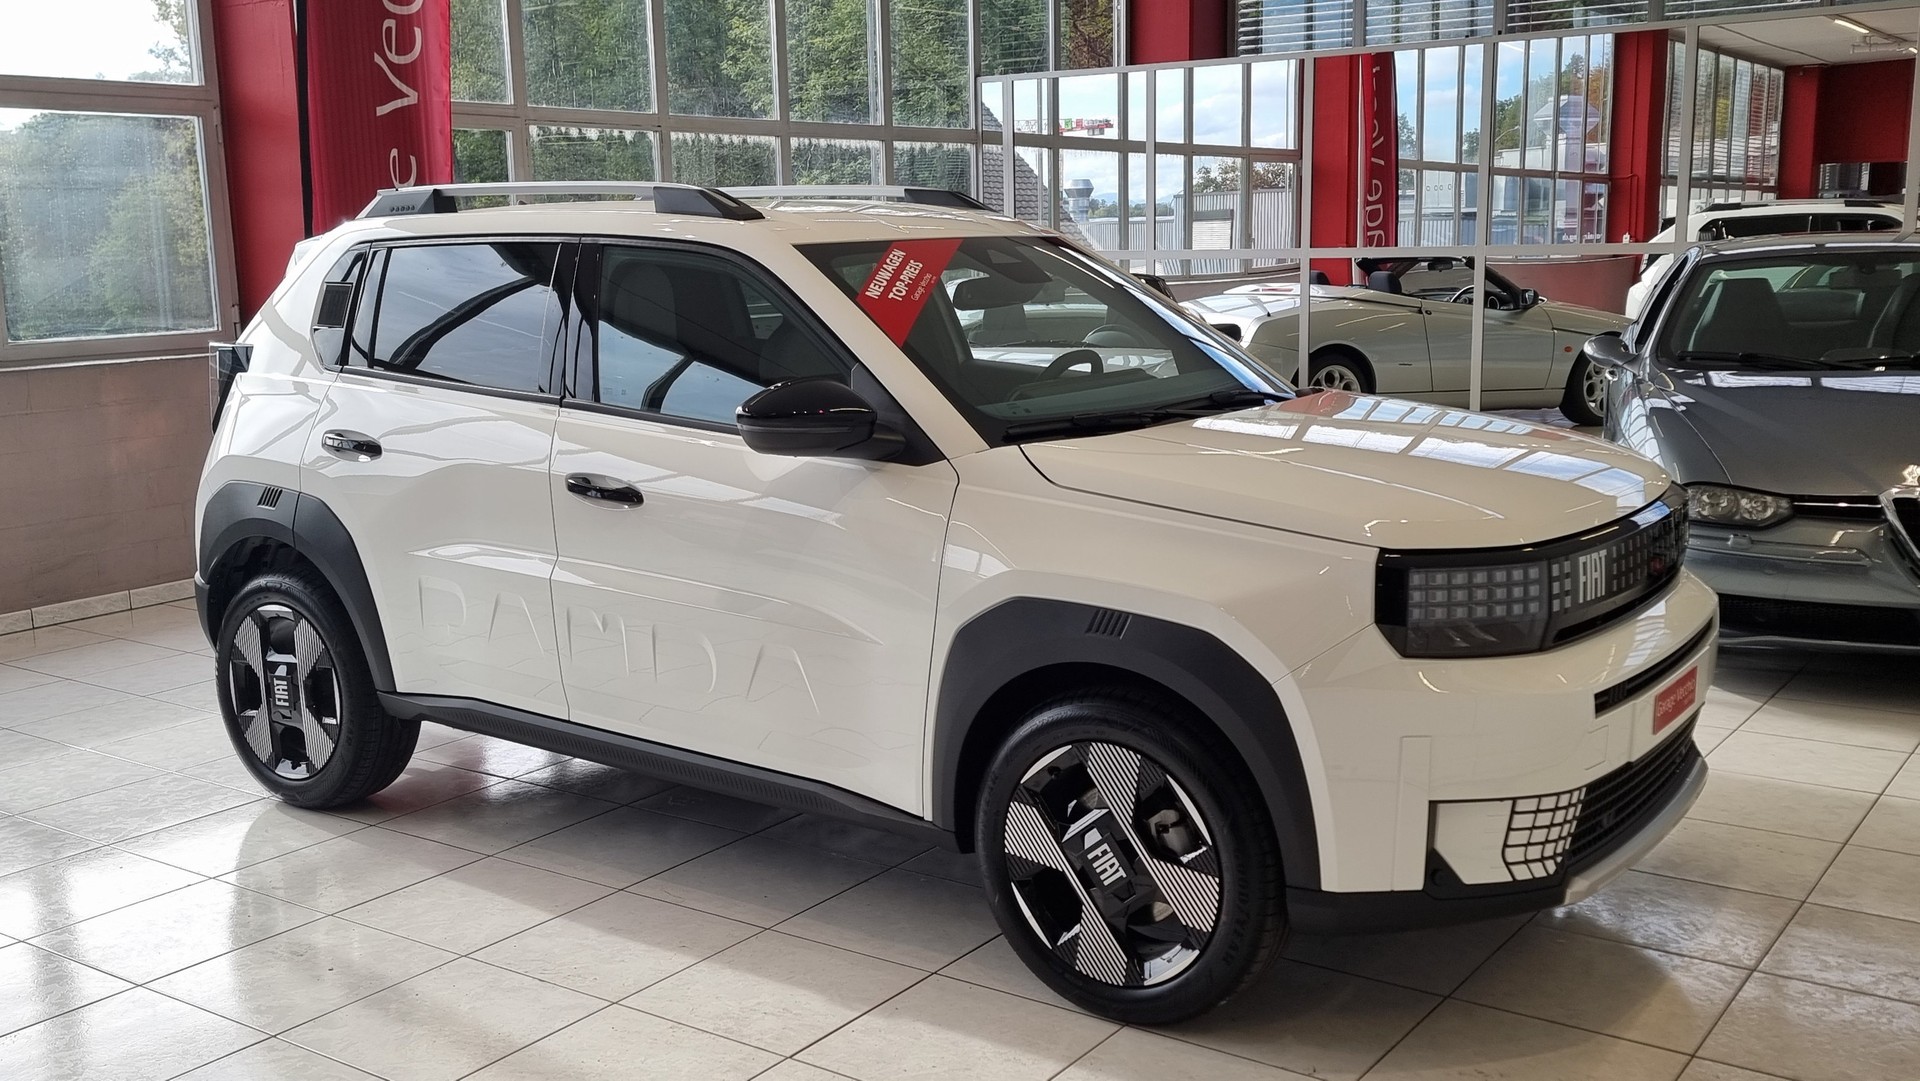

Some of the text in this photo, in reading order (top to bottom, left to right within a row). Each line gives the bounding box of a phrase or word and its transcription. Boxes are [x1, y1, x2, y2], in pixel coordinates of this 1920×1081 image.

[865, 248, 906, 299] NEUWAGEN
[888, 260, 923, 301] TOP-PREIS
[1579, 549, 1607, 603] FIAT
[418, 575, 820, 715] PANDA
[273, 677, 290, 706] FIAT
[1086, 842, 1127, 886] FIAT
